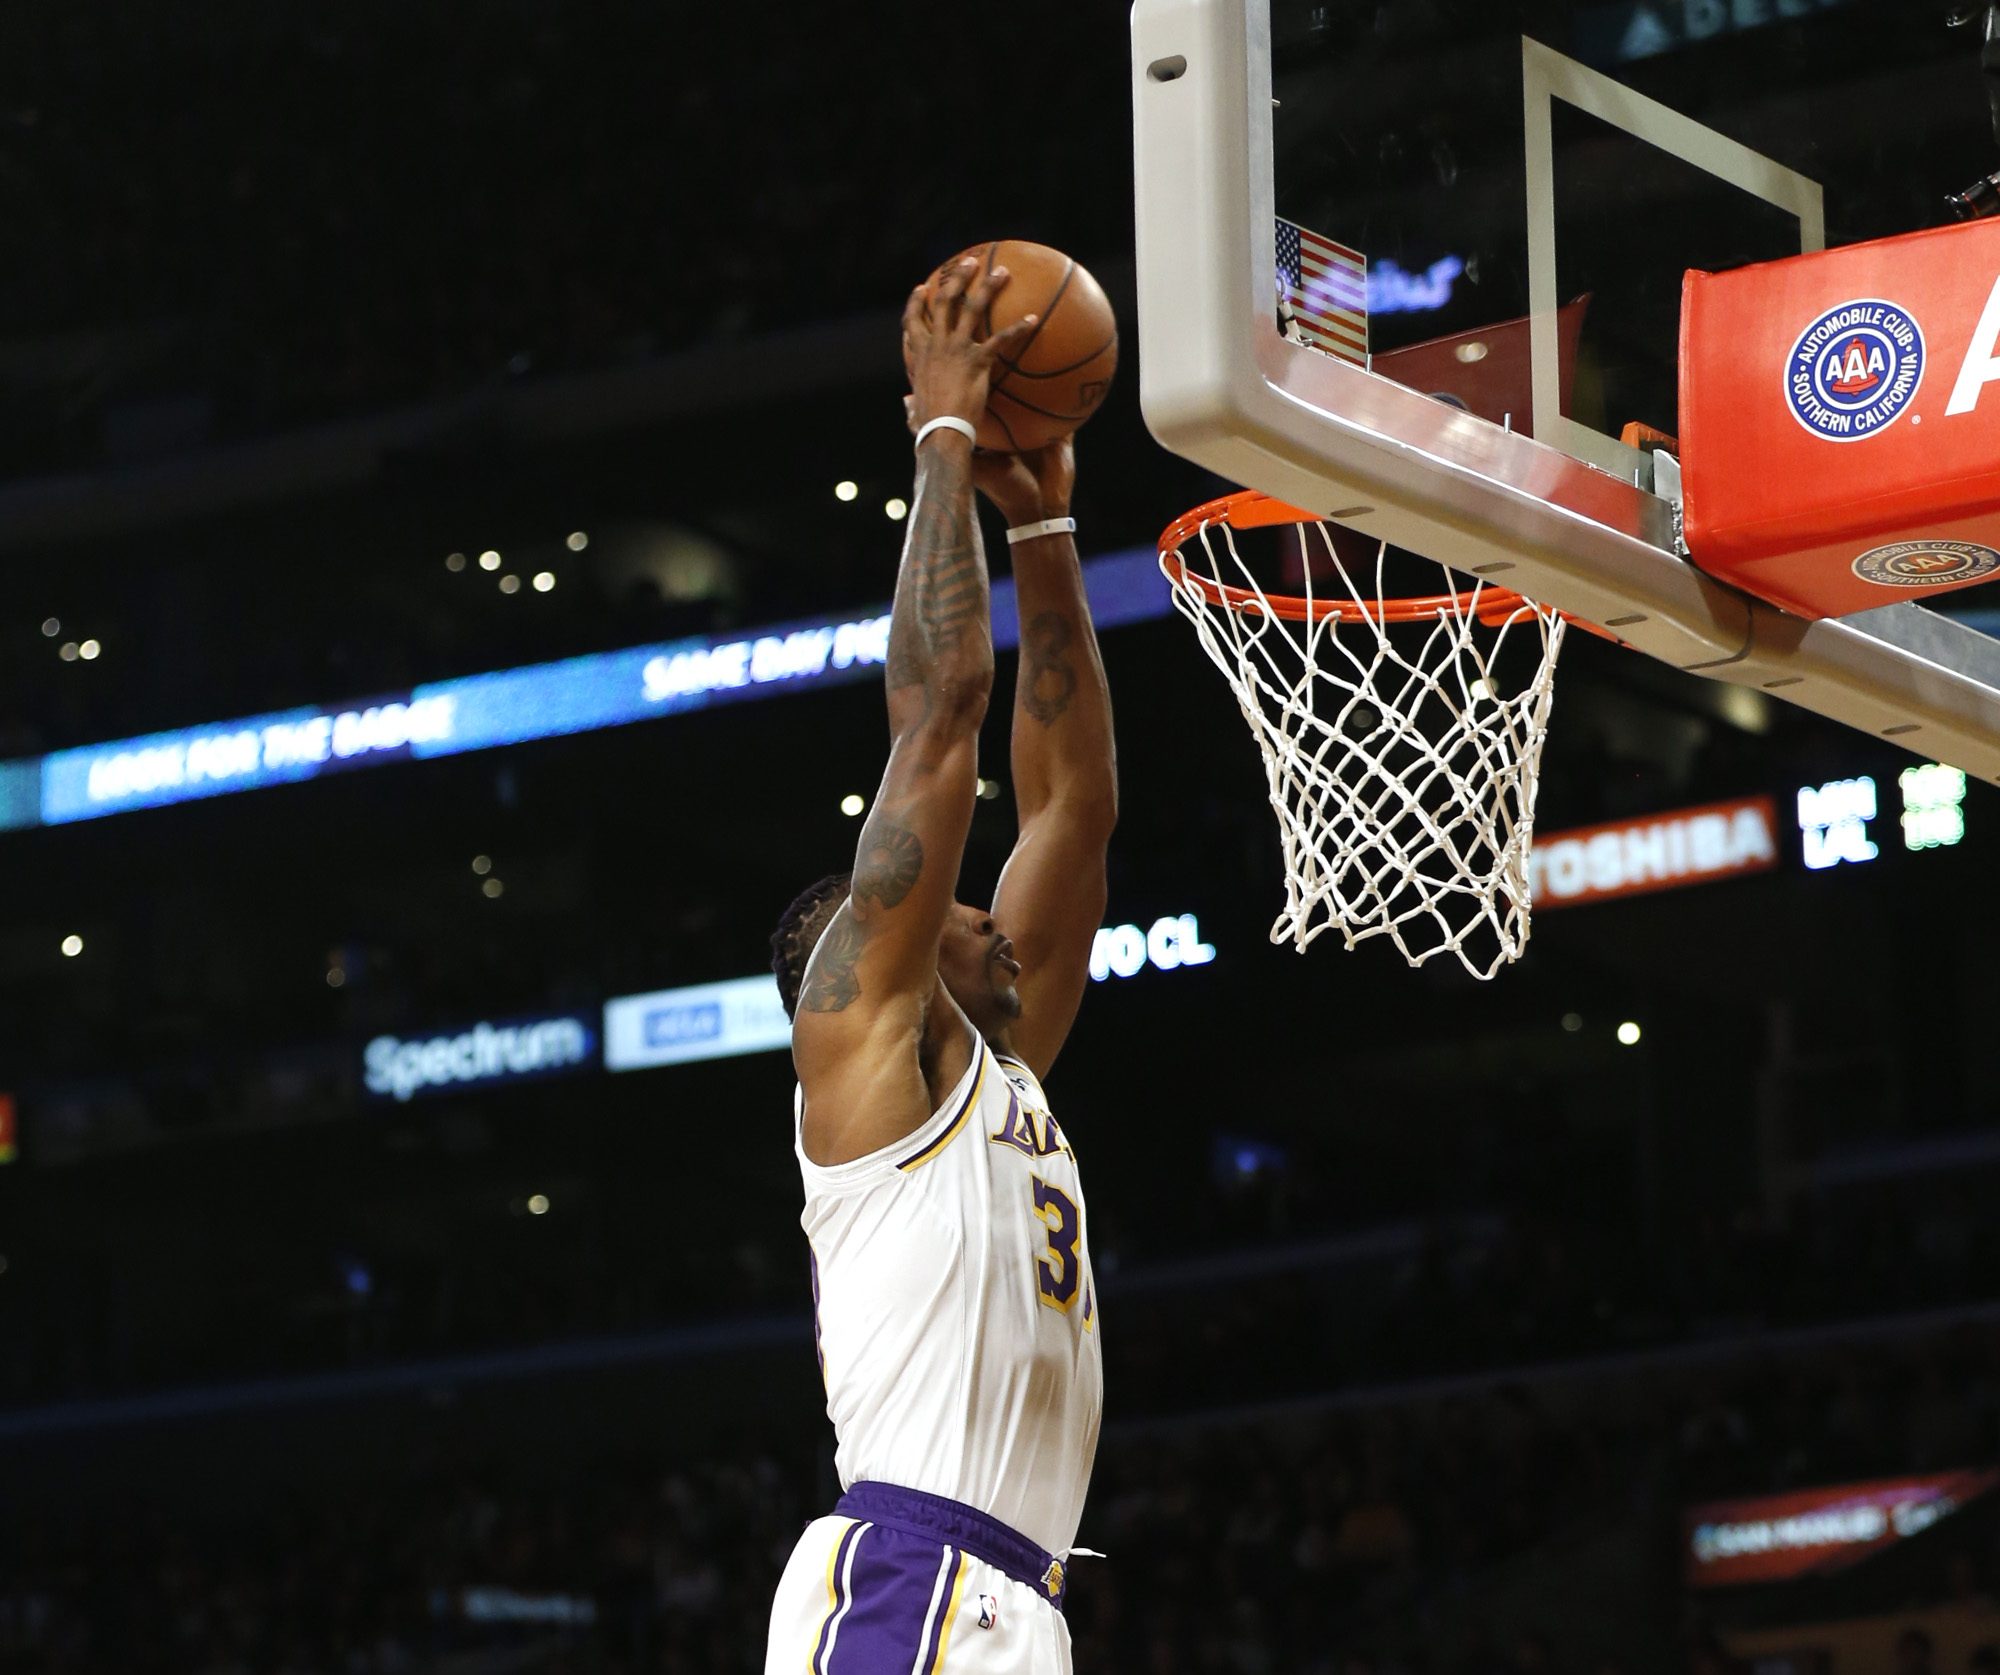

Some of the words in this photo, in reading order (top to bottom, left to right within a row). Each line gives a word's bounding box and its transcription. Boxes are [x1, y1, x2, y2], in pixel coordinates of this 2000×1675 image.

[1798, 307, 1885, 364] AUTOMOBILE
[1883, 313, 1915, 348] CLUB
[1825, 347, 1885, 383] AAA
[1793, 373, 1851, 433] SOUTHERN
[1854, 352, 1918, 431] CALIFORNIA
[1898, 553, 1960, 573] AAA
[1529, 806, 1776, 900] TOSHIBA
[363, 1017, 587, 1102] Spectrum
